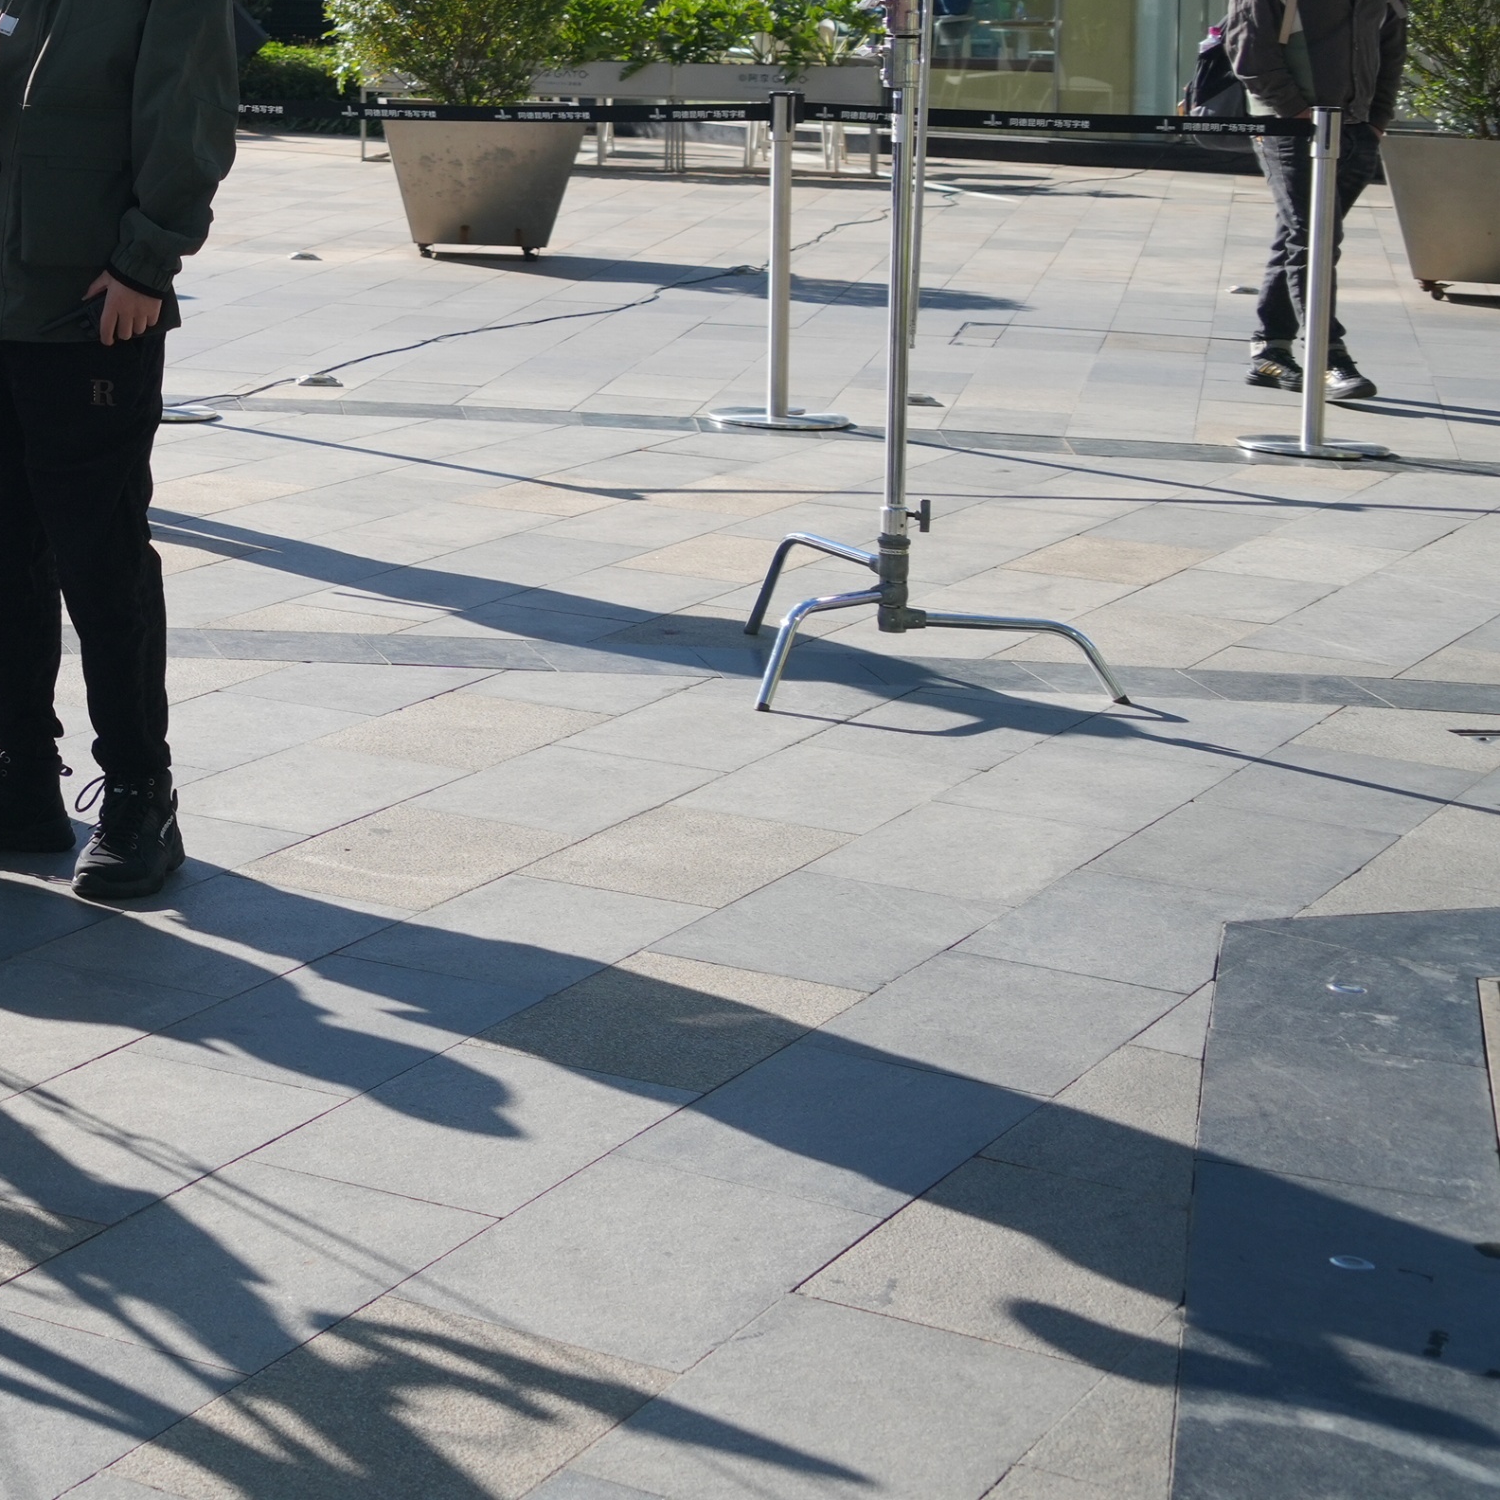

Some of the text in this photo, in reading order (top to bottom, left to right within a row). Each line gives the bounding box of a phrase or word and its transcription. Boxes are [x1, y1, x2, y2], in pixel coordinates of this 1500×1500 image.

[364, 108, 437, 119] 同德昆明广场写字楼
[517, 110, 591, 121] 同德昆明广场写字楼
[672, 110, 746, 120] 同德昆明广场写字楼
[1009, 117, 1091, 129] 同德昆明广场写字楼
[1182, 122, 1266, 134] 同德昆明广场写字楼
